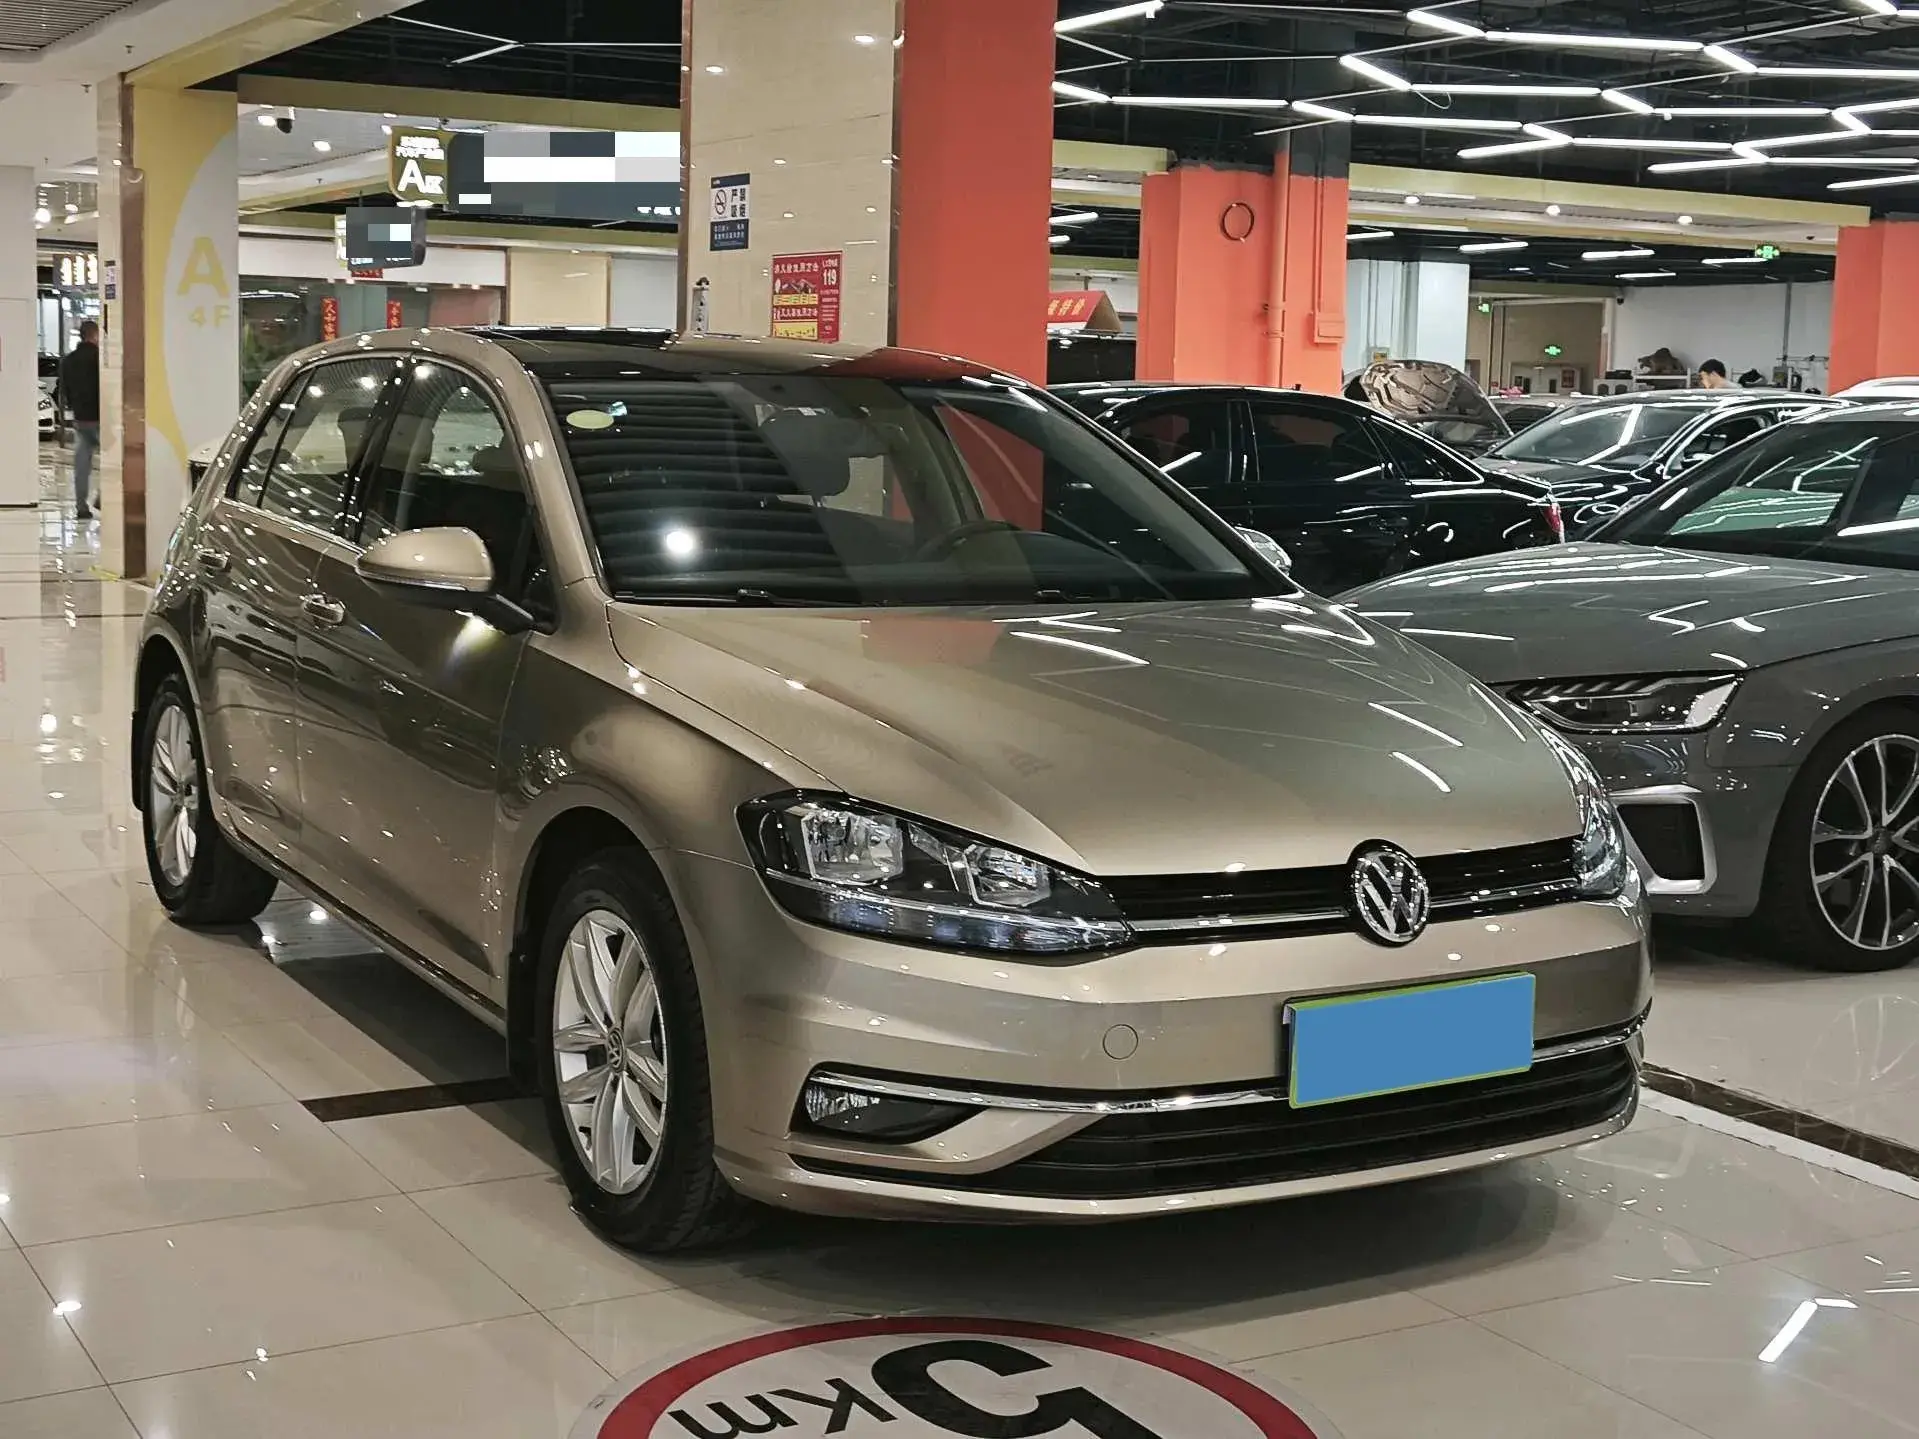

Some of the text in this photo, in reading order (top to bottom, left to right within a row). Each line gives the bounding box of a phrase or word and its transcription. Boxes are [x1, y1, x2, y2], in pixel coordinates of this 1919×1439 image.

[177, 237, 231, 298] A
[823, 269, 837, 286] 119
[188, 305, 231, 328] 4F
